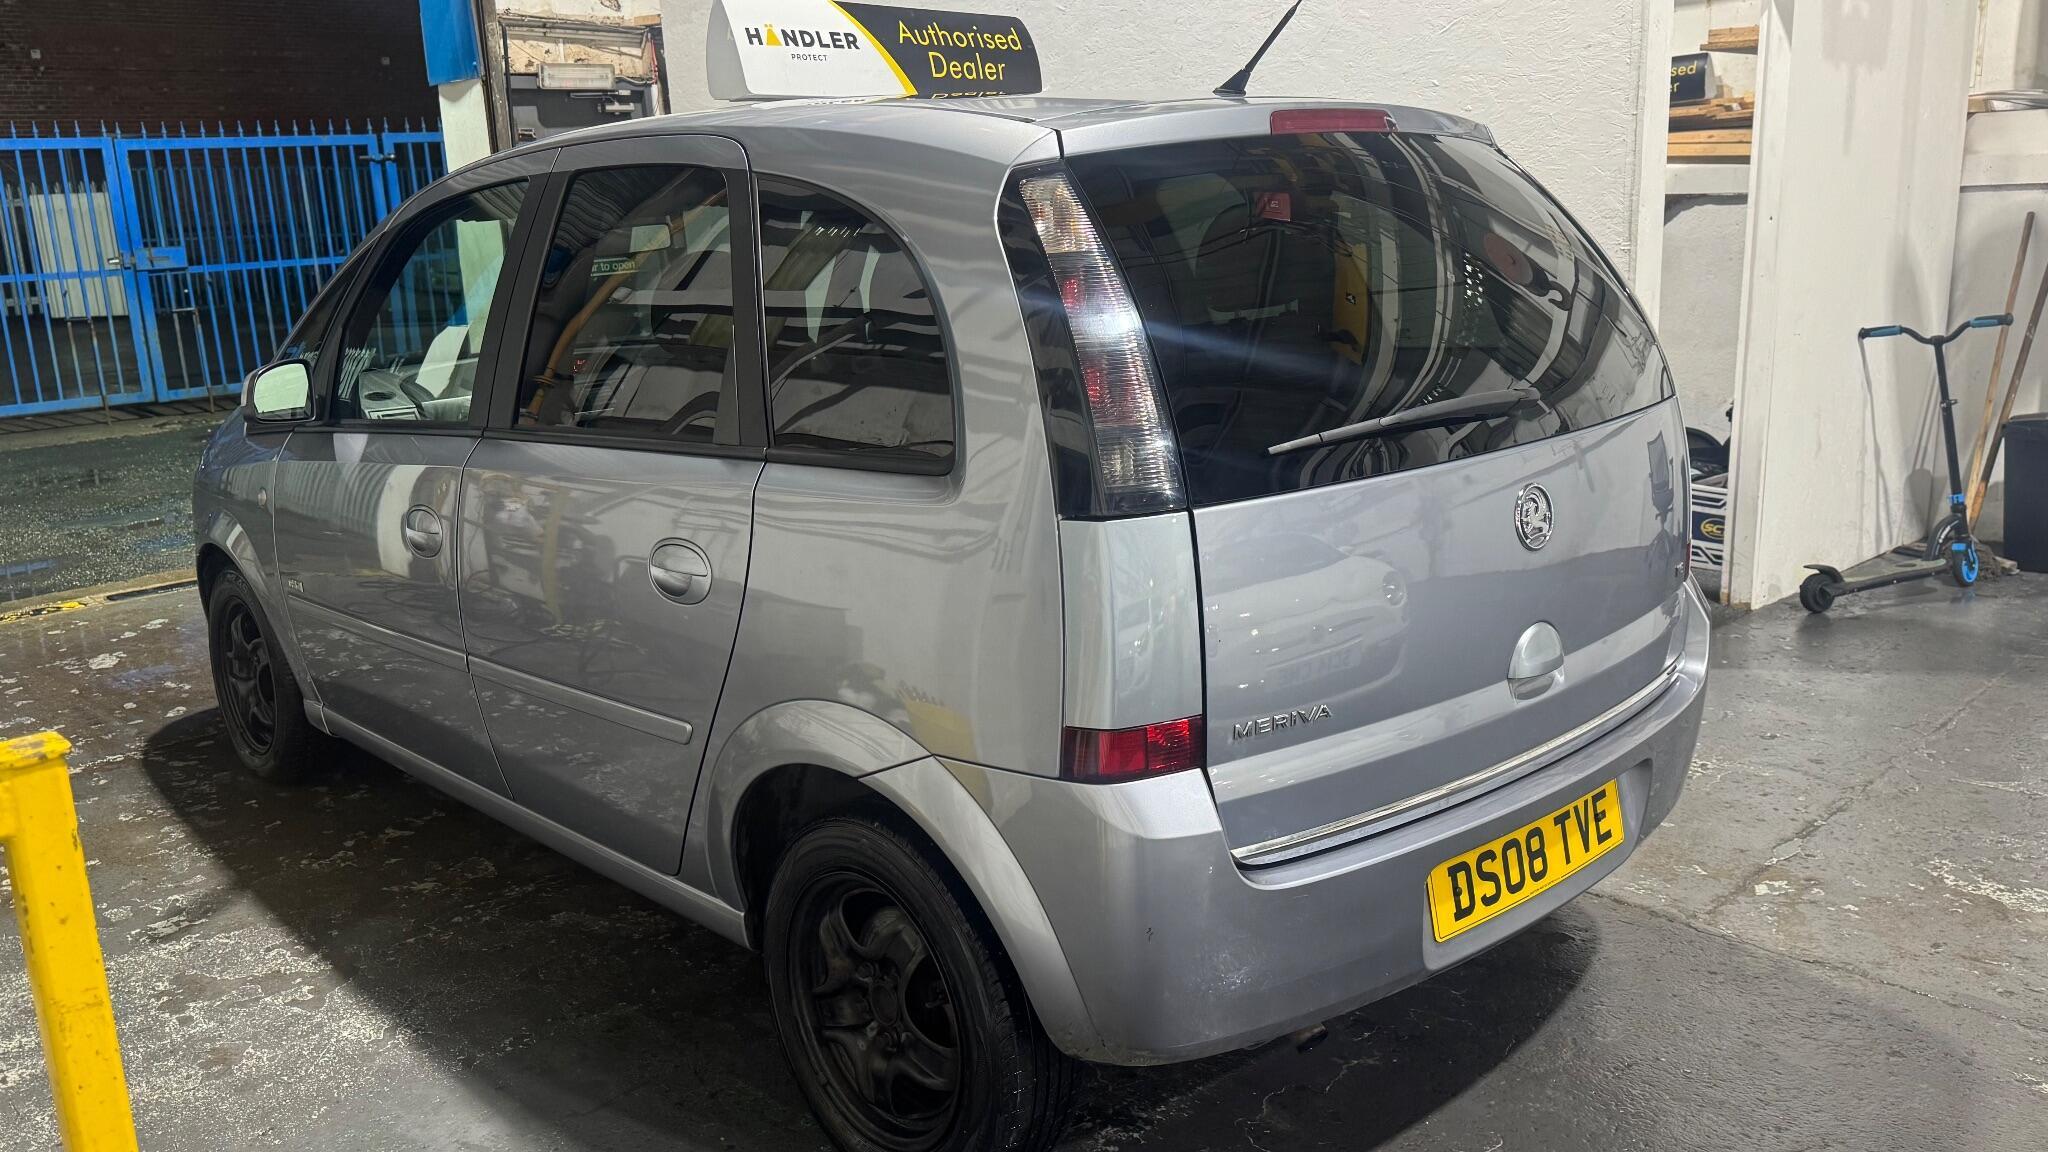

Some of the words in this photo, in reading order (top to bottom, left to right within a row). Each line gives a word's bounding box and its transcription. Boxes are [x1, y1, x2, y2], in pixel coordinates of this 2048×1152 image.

[744, 24, 860, 50] HÄNDLER
[898, 20, 1023, 52] Authorised
[791, 53, 828, 62] PROTECT
[928, 51, 1006, 81] Dealer
[600, 262, 610, 271] to
[612, 261, 635, 271] open
[1233, 703, 1332, 741] MERIVA
[1447, 826, 1549, 922] DS08
[1553, 788, 1612, 866] TVE
